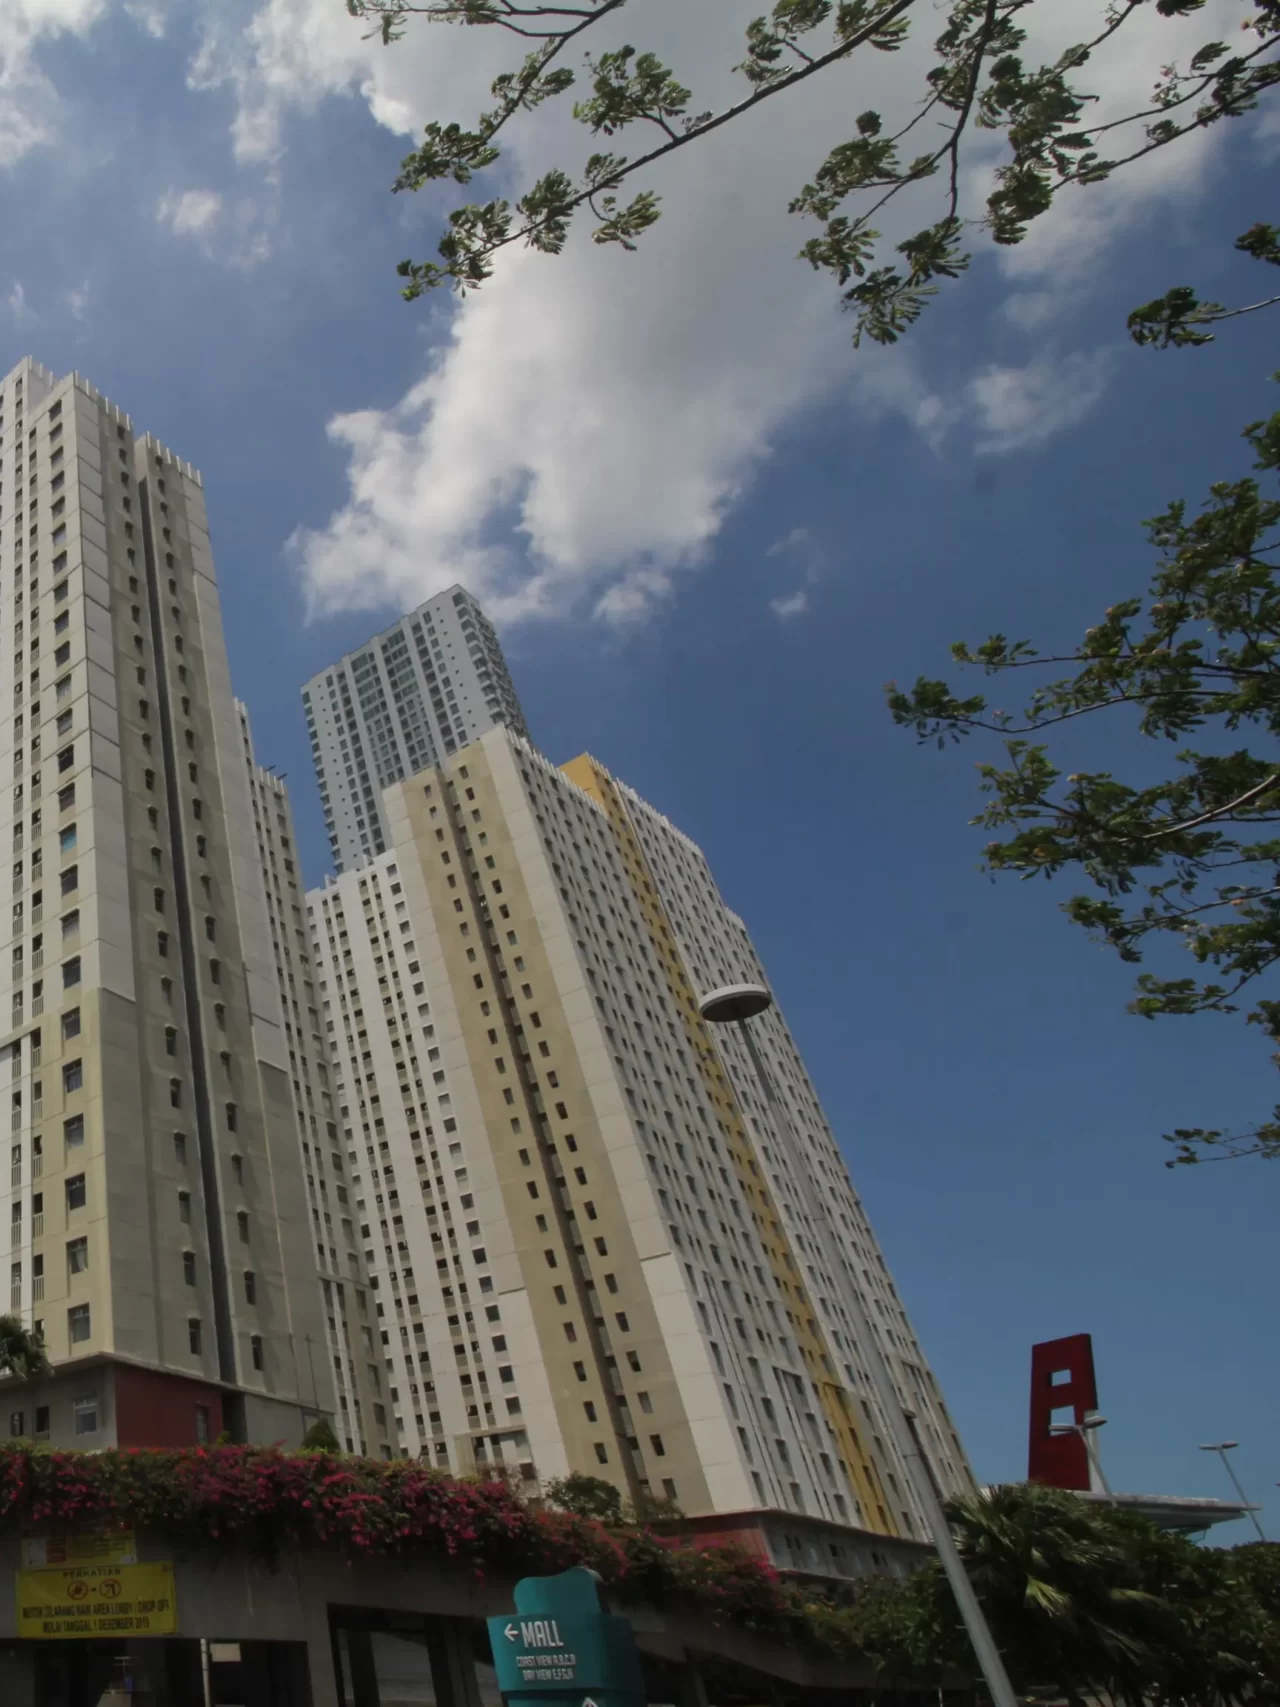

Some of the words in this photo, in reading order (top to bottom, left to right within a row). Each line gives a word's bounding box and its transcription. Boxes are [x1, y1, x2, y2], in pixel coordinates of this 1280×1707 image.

[22, 1606, 43, 1619] MOTOR
[93, 1602, 110, 1615] AREA
[138, 1600, 155, 1613] DROP
[157, 1599, 169, 1612] OFF
[43, 1622, 62, 1633] MULAI
[63, 1619, 92, 1632] TANGGAL
[98, 1617, 134, 1631] DESEMBER
[520, 1620, 564, 1648] MALL
[516, 1656, 536, 1667] COAST
[536, 1655, 552, 1666] VIEW
[536, 1669, 552, 1680] VIEW
